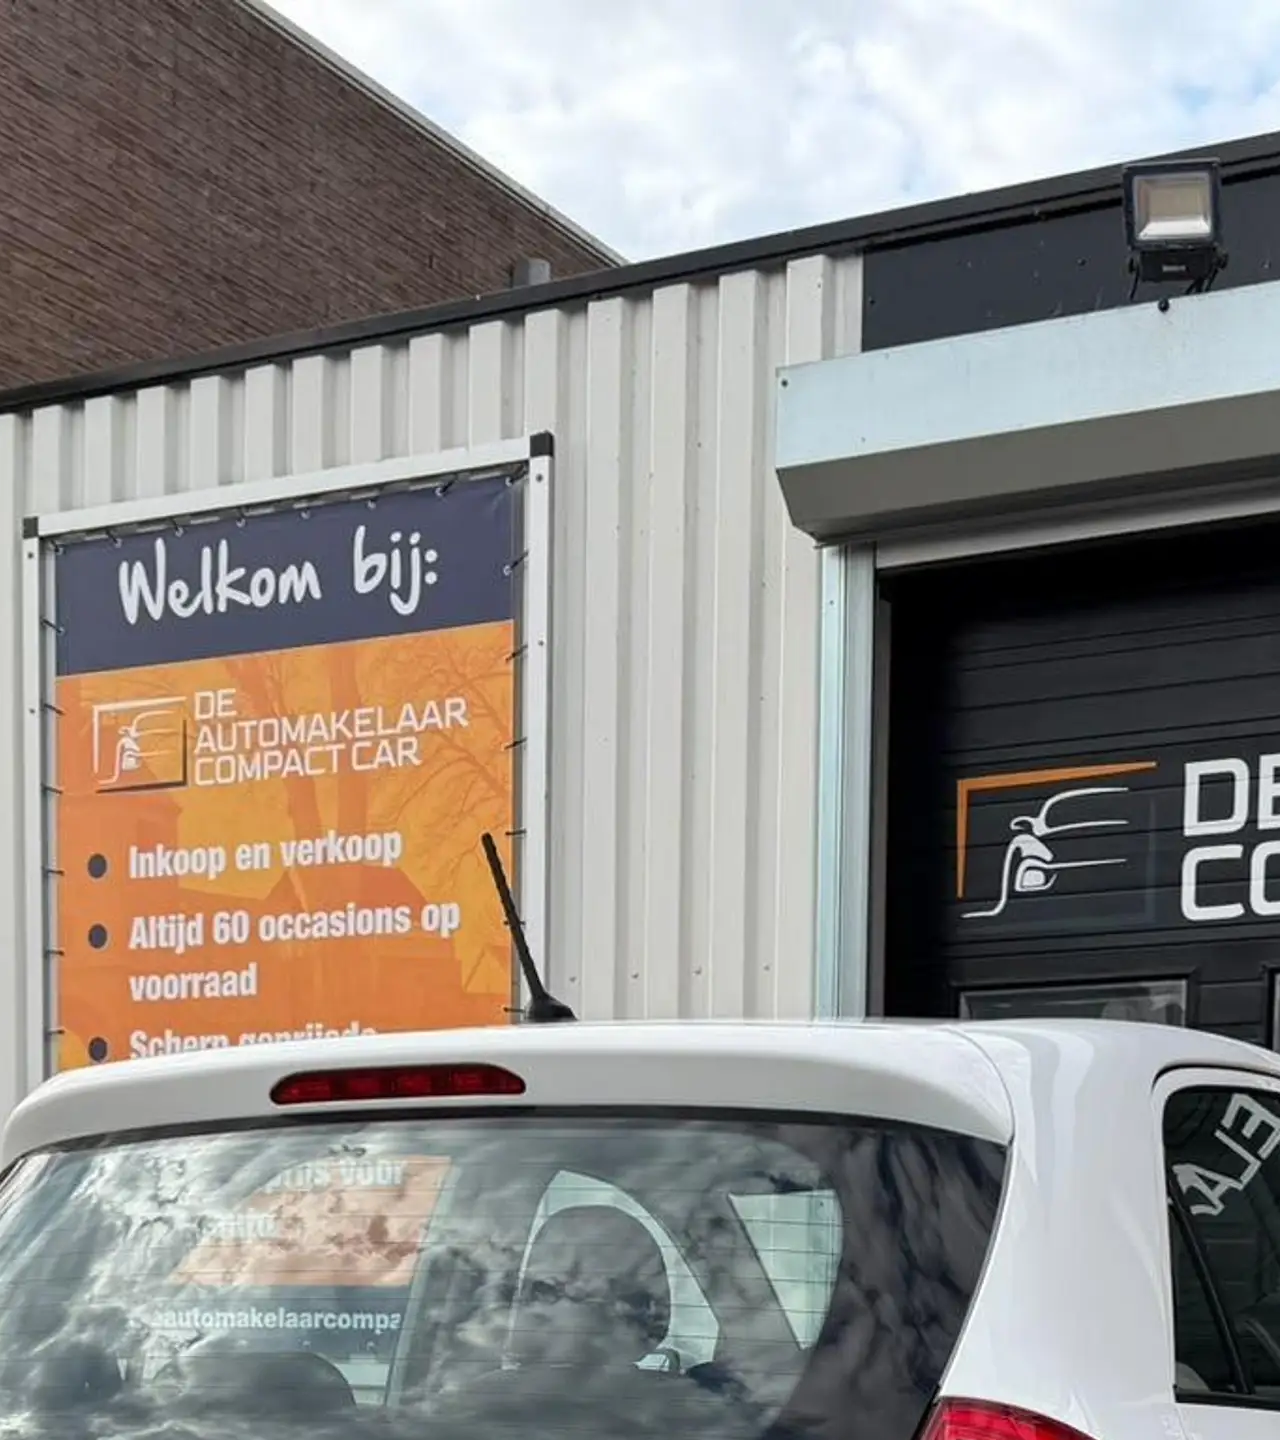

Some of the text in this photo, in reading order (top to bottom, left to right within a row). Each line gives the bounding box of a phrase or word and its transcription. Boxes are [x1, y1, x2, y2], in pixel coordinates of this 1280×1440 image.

[119, 525, 439, 625] Welkom bij:
[193, 696, 469, 754] AUTOMAKELAAR
[194, 687, 237, 721] DE
[194, 736, 422, 786] COMPACT CAR
[129, 829, 402, 880] Inkoop en verkoop
[128, 902, 461, 954] Altijd 60 occasions op
[129, 962, 258, 1001] voorraad
